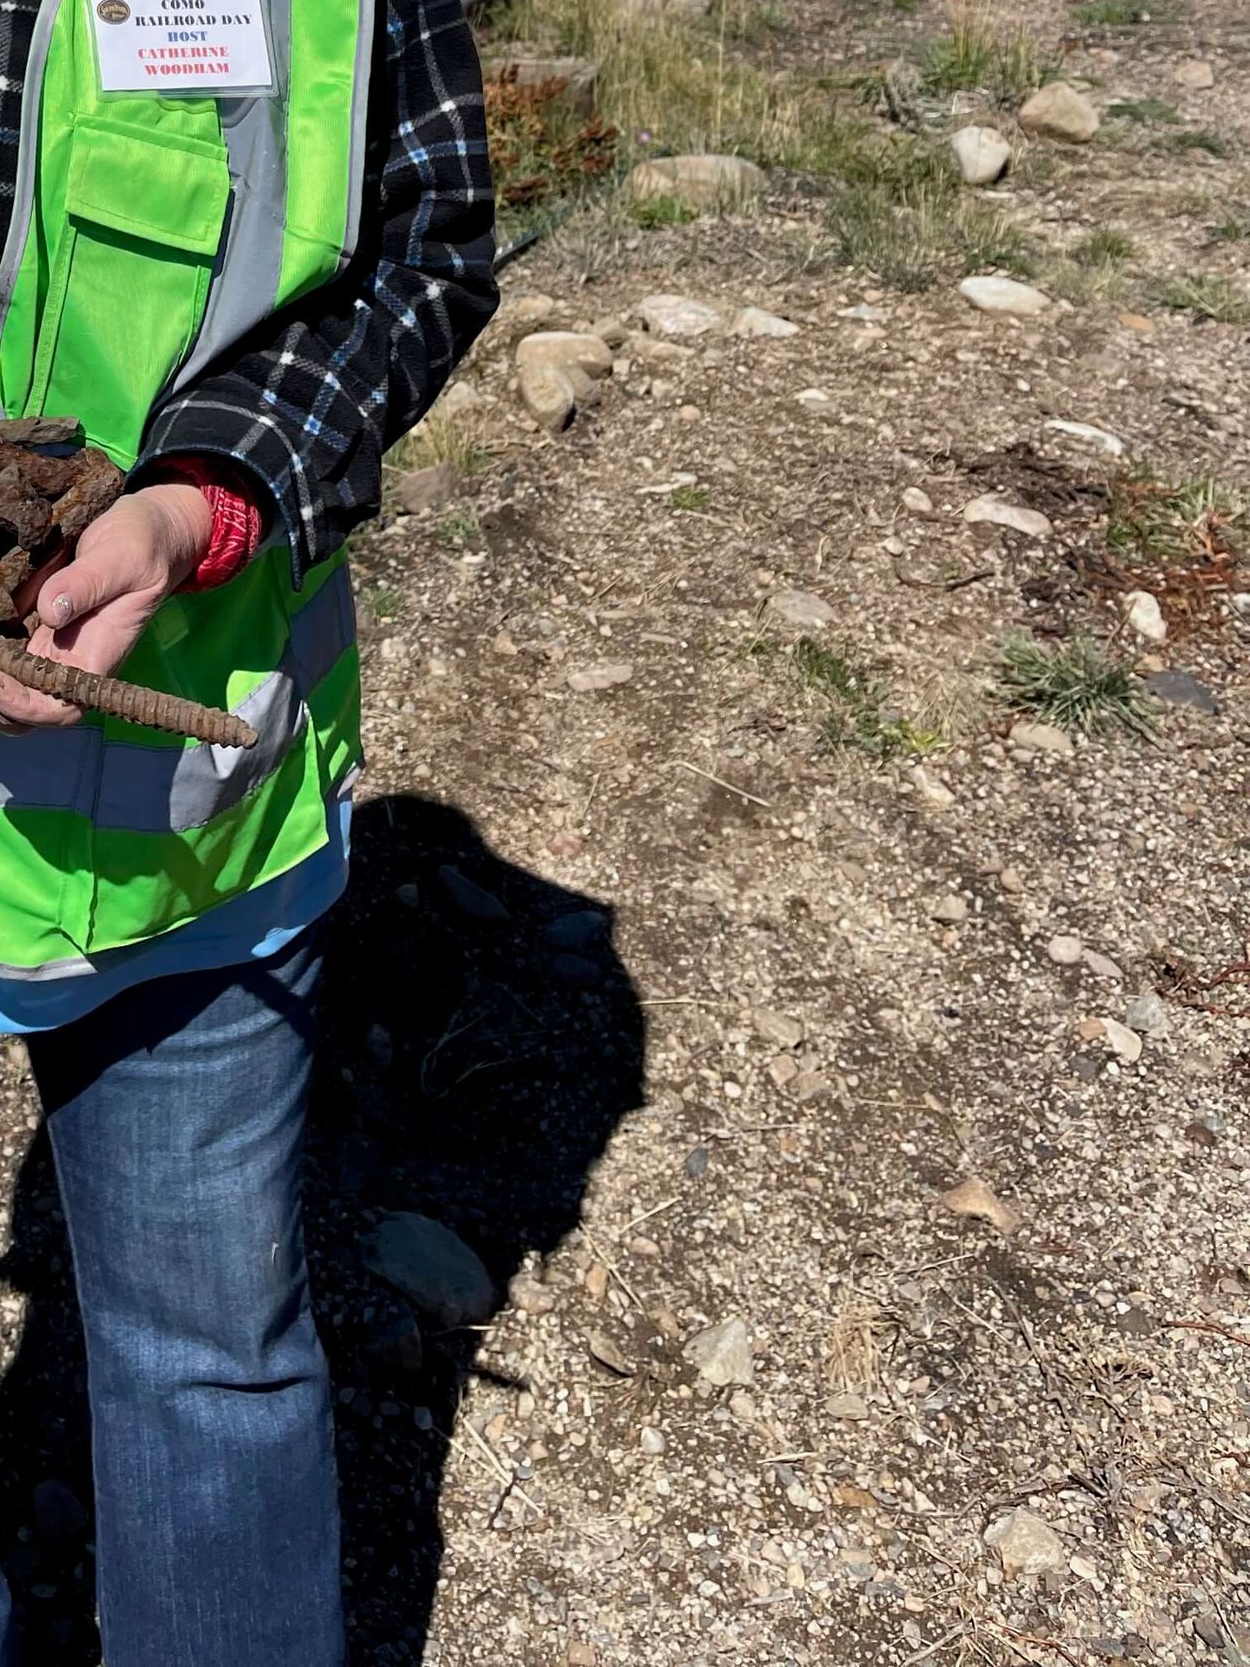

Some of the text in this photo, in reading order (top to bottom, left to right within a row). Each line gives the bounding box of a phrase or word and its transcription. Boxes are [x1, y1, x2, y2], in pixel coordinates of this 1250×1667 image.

[161, 0, 205, 10] COMO
[135, 14, 251, 26] RAILROAD DAY
[168, 31, 207, 42] HOST
[138, 47, 229, 59] CATHERINE
[145, 63, 229, 75] WOODHAM
